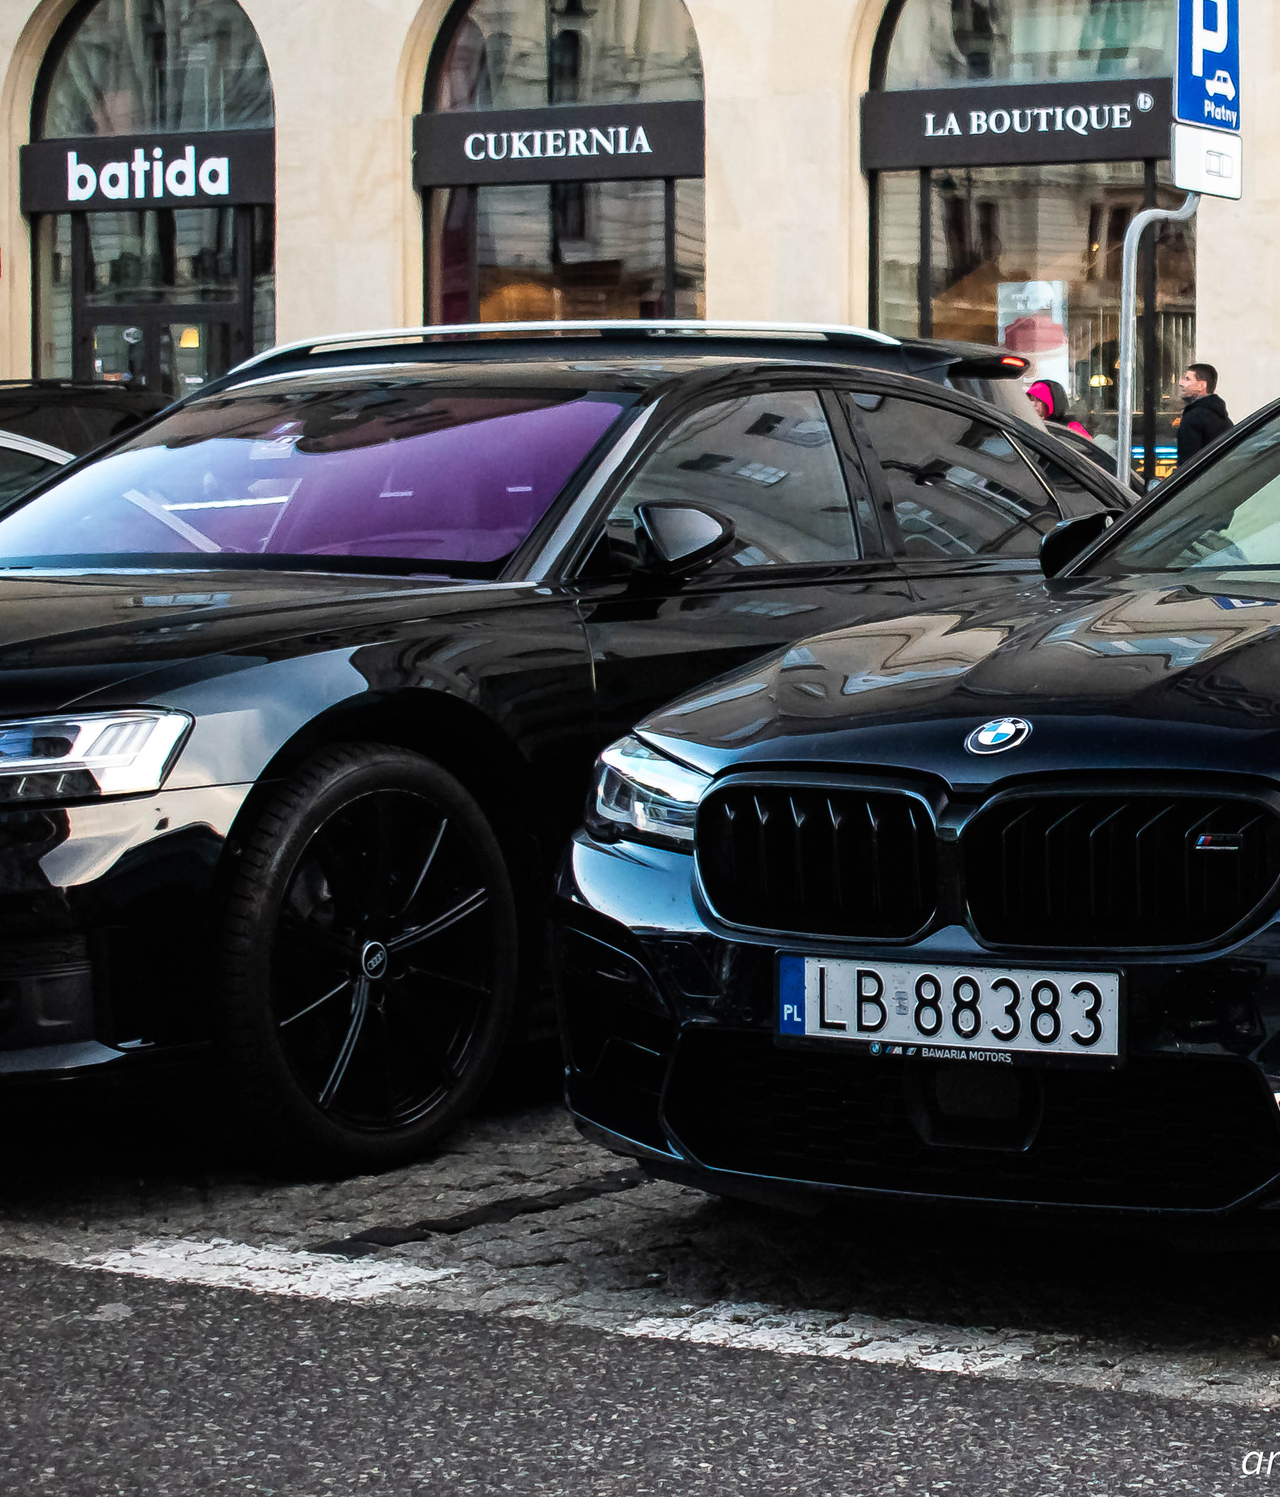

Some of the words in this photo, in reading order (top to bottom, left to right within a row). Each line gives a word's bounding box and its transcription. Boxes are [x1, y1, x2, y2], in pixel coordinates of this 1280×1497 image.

[1192, 0, 1228, 77] P
[924, 111, 963, 138] LA
[969, 104, 1133, 136] BOUTIQUE
[464, 125, 653, 162] CUKIERNIA
[67, 146, 230, 202] batida
[783, 1003, 802, 1022] PL
[818, 966, 888, 1033] LB
[913, 971, 1104, 1047] 88383
[922, 1047, 967, 1060] BAWARIA
[969, 1050, 1012, 1063] MOTORS
